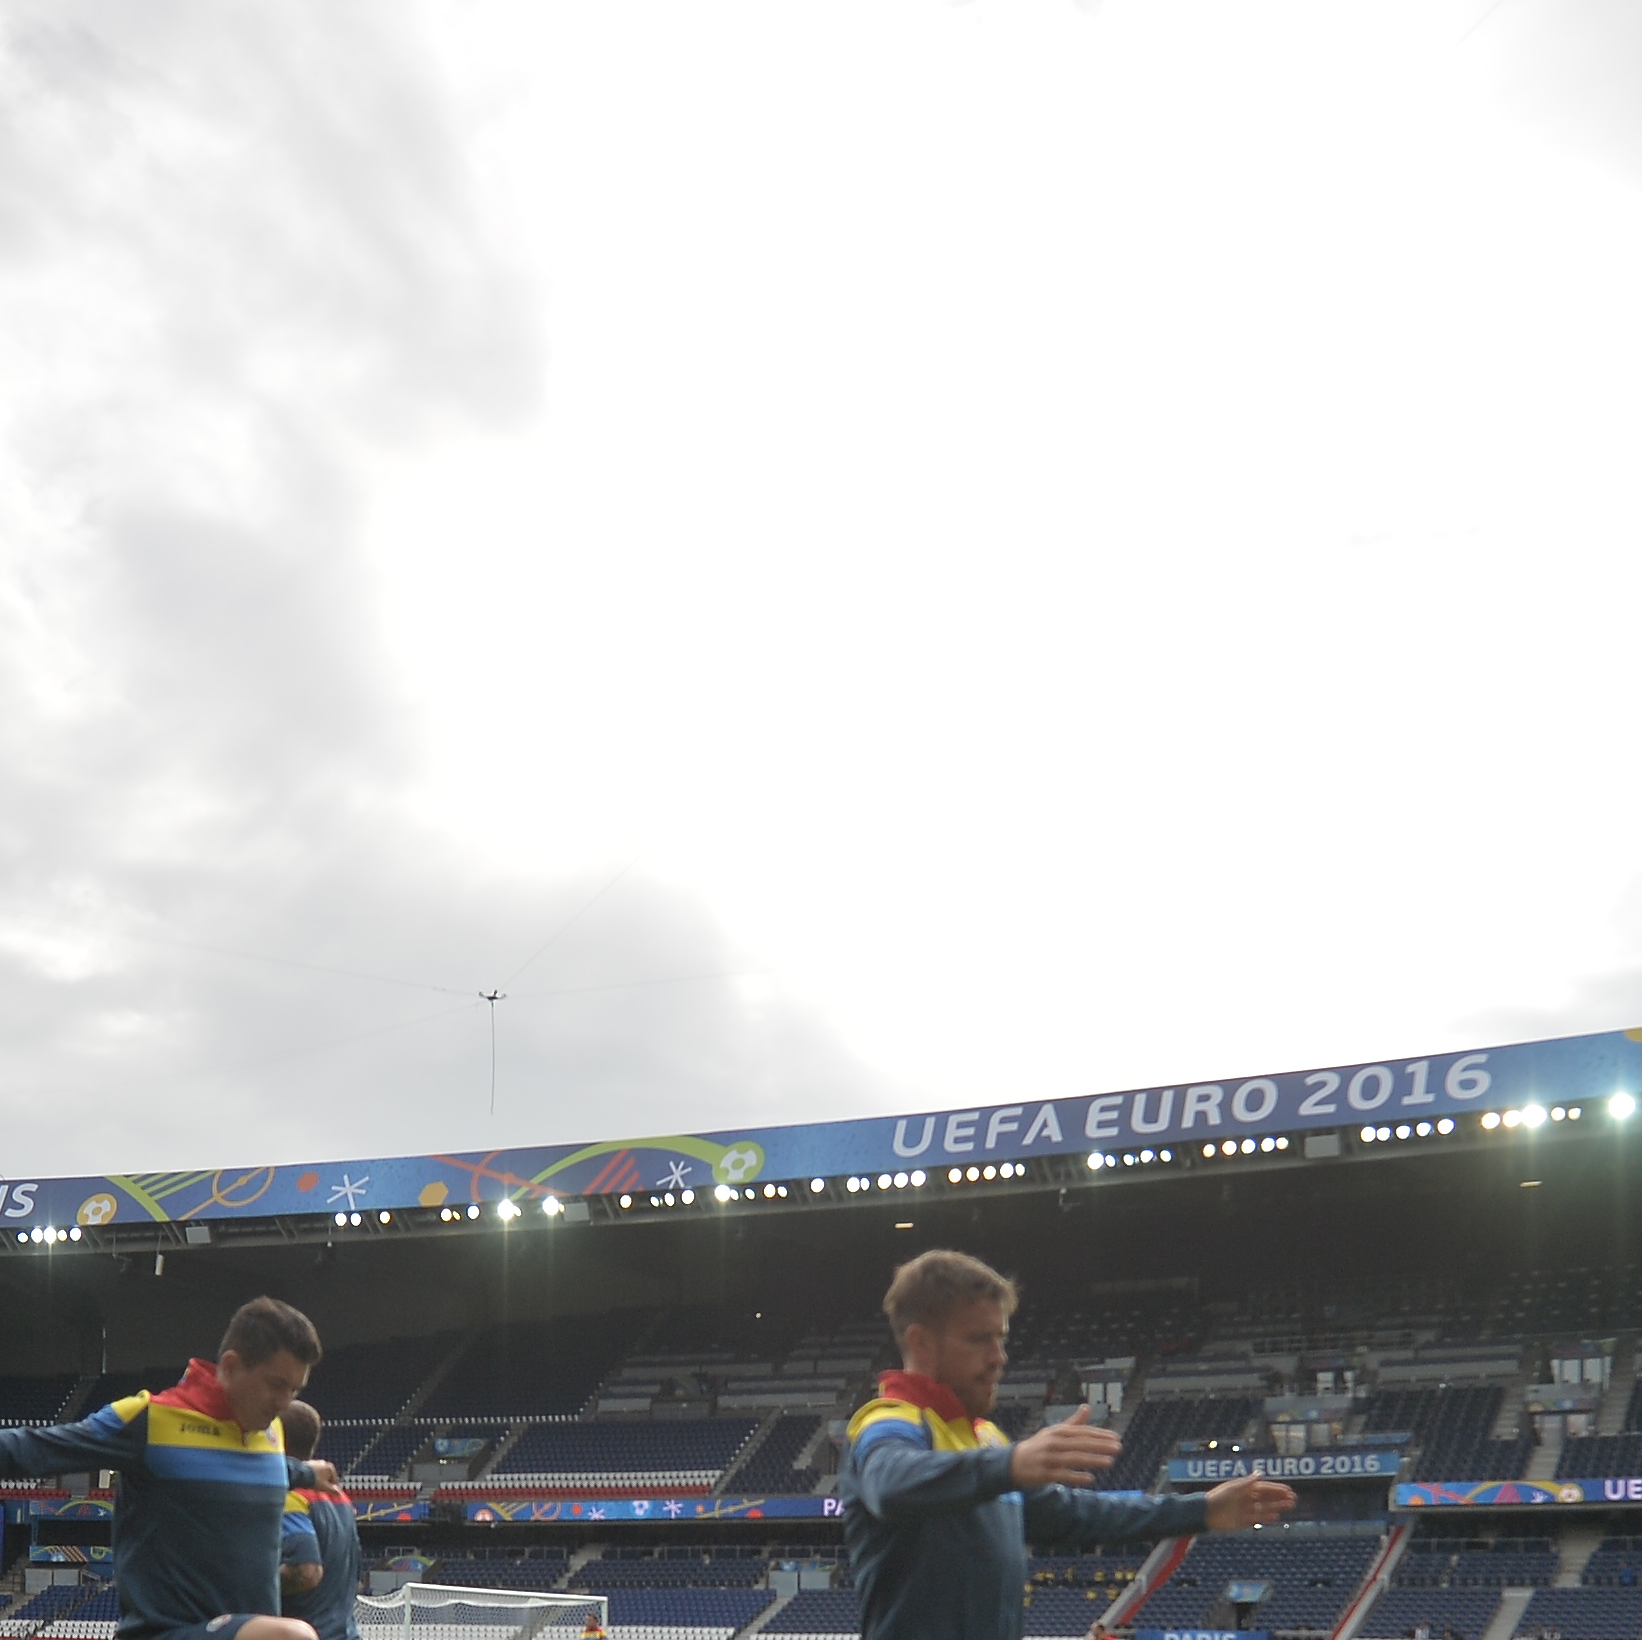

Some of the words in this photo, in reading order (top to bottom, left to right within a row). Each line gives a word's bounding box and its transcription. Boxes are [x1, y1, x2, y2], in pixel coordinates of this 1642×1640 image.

[891, 1104, 1063, 1159] UEFA
[1083, 1077, 1279, 1139] EURO
[1297, 1053, 1492, 1117] 2016
[1187, 1459, 1247, 1478] UEFA
[1252, 1456, 1316, 1476] EURO
[1320, 1454, 1381, 1474] 2016
